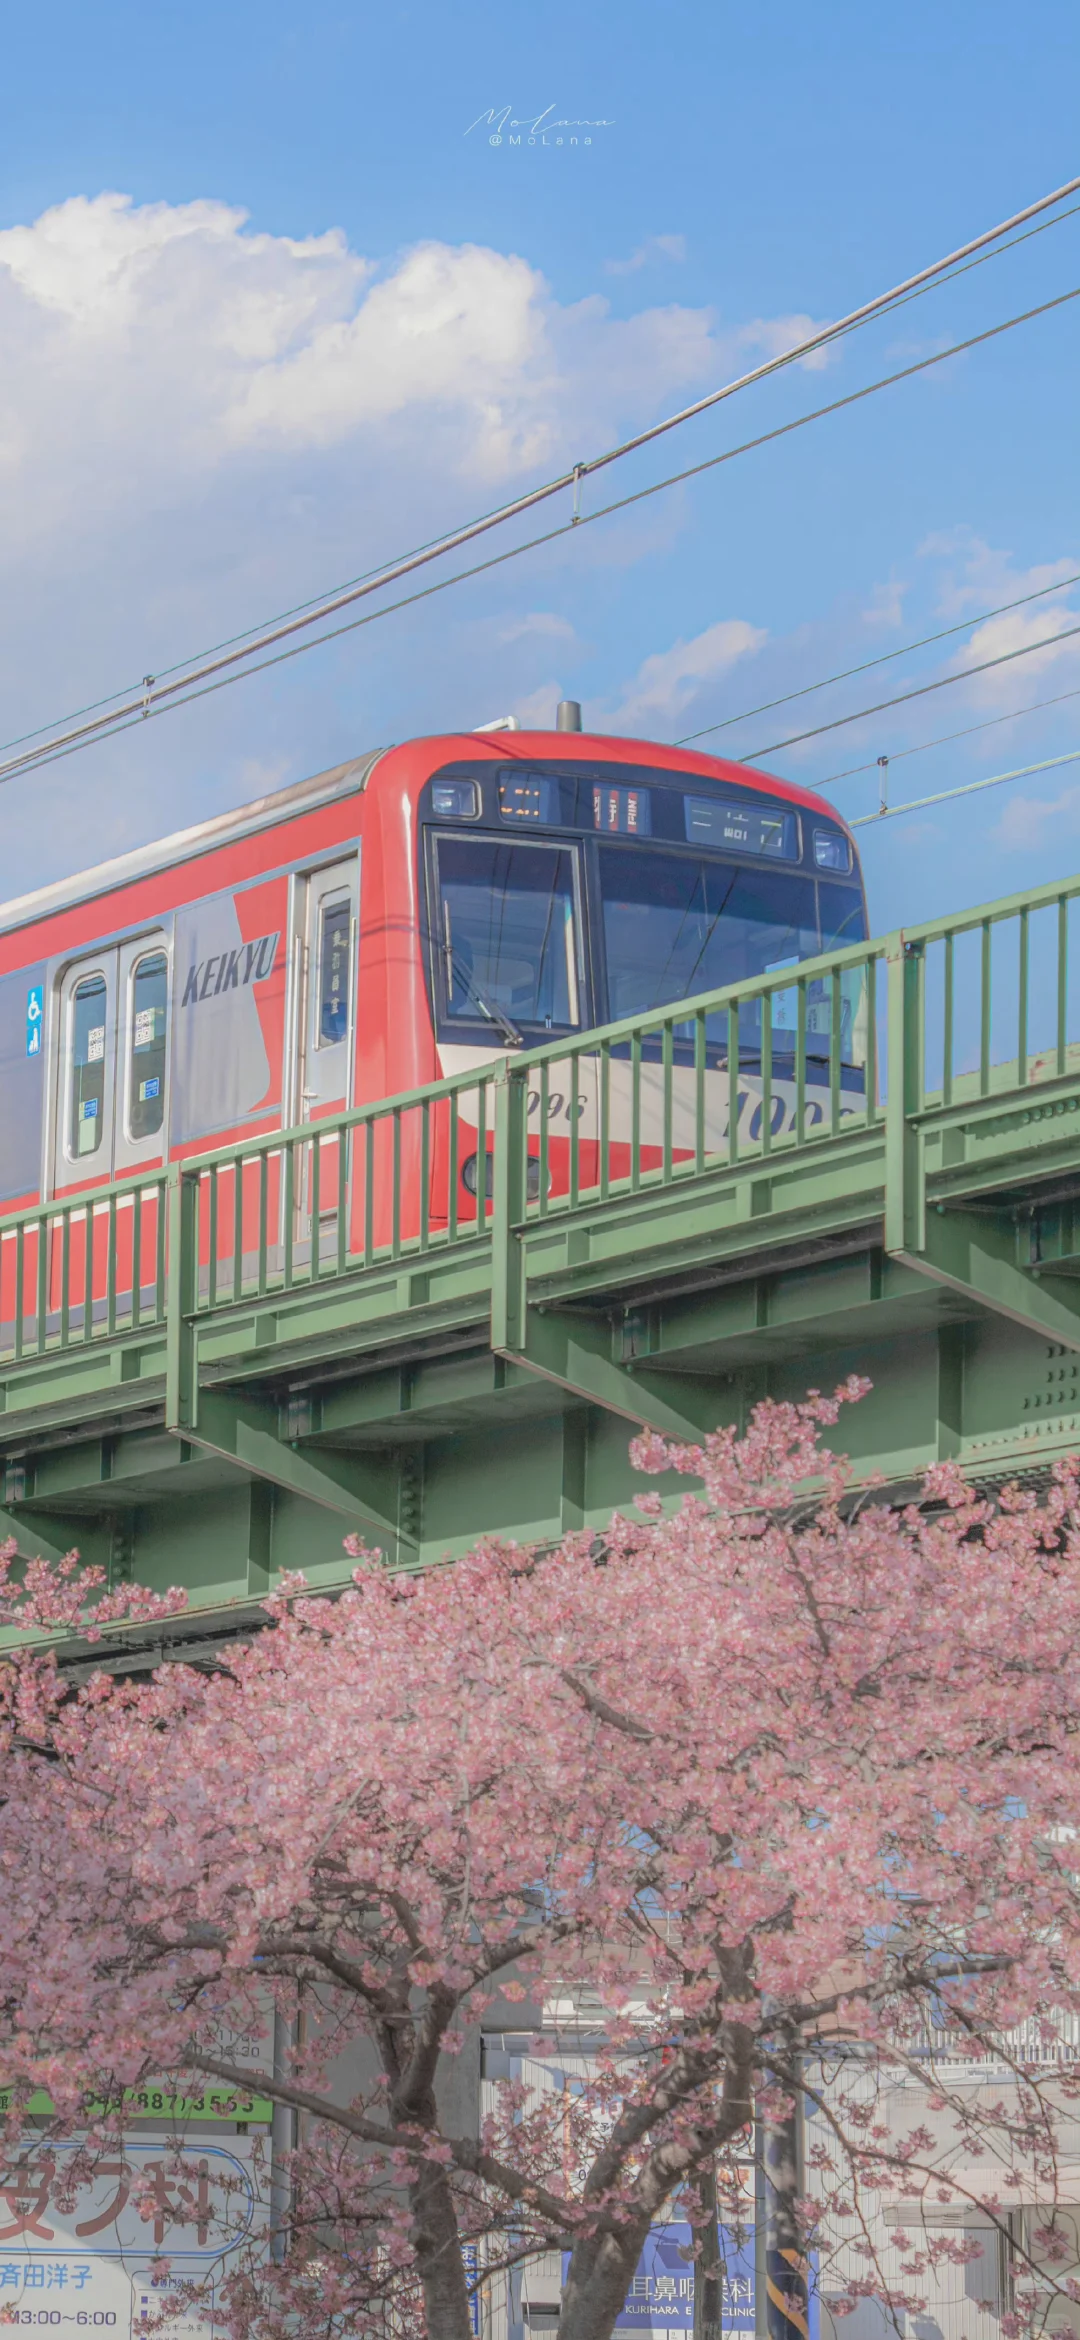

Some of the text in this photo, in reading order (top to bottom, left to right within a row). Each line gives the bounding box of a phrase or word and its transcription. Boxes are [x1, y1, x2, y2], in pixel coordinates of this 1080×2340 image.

[181, 931, 280, 1008] KEIKYU
[722, 1091, 856, 1141] 100
[625, 2305, 680, 2315] KURIHARA
